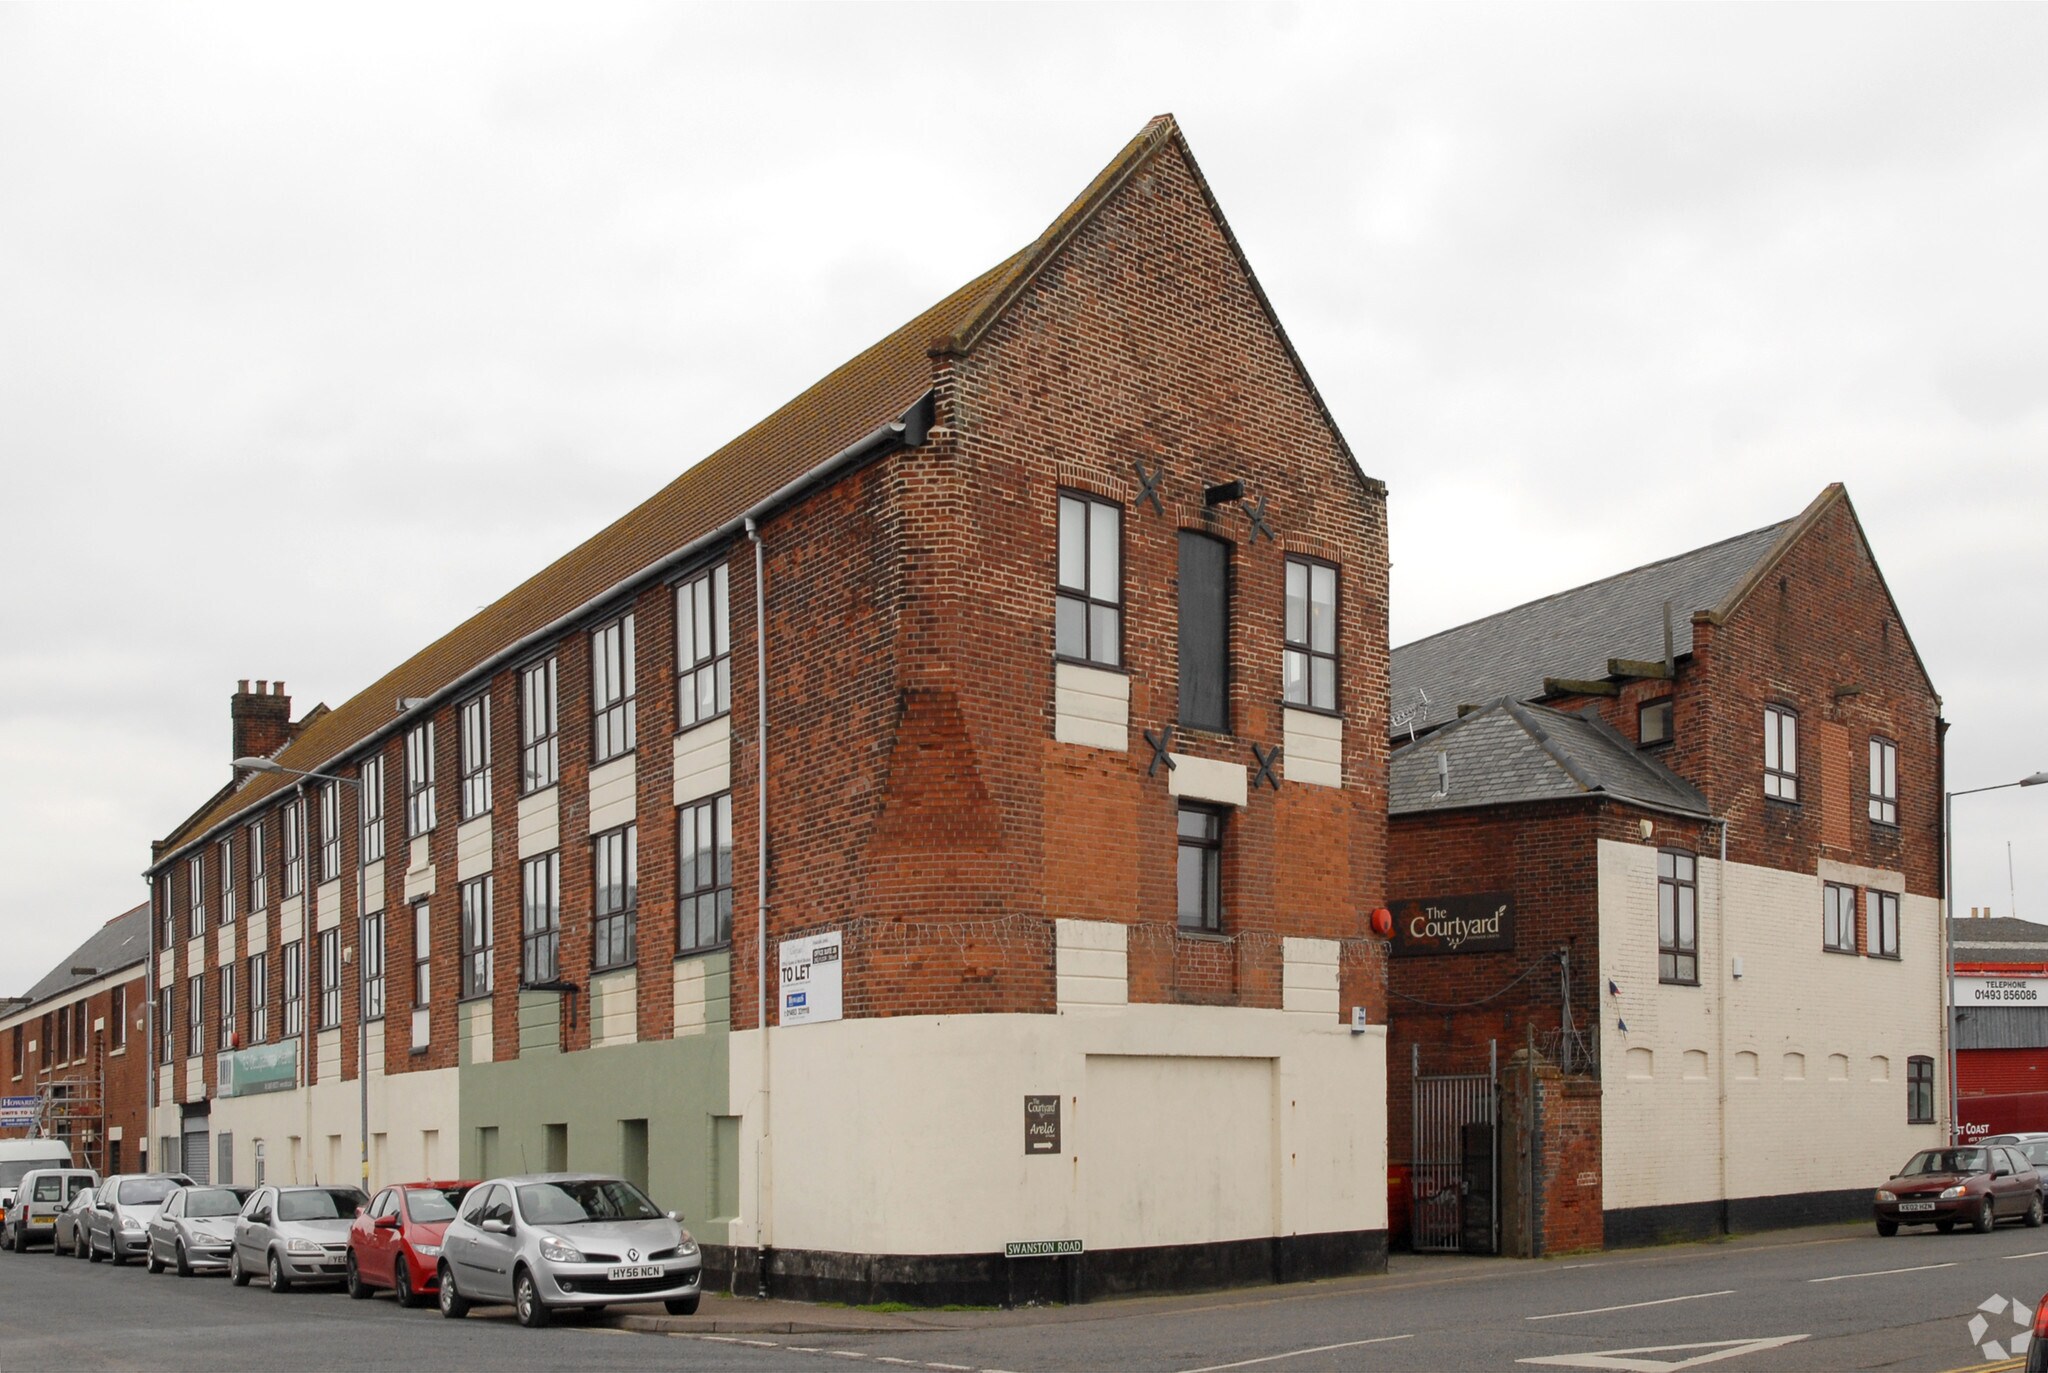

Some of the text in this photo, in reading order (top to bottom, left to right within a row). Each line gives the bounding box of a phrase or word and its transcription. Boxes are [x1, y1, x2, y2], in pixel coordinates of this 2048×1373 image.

[1426, 907, 1447, 919] The
[1410, 911, 1499, 944] Courtyard
[781, 963, 811, 983] TO LET
[1975, 989, 2037, 1000] 01493 856086
[1966, 1122, 1990, 1135] COAST
[1008, 1241, 1081, 1254] SWANSTON ROAD
[613, 1266, 660, 1278] HY56 NCN
